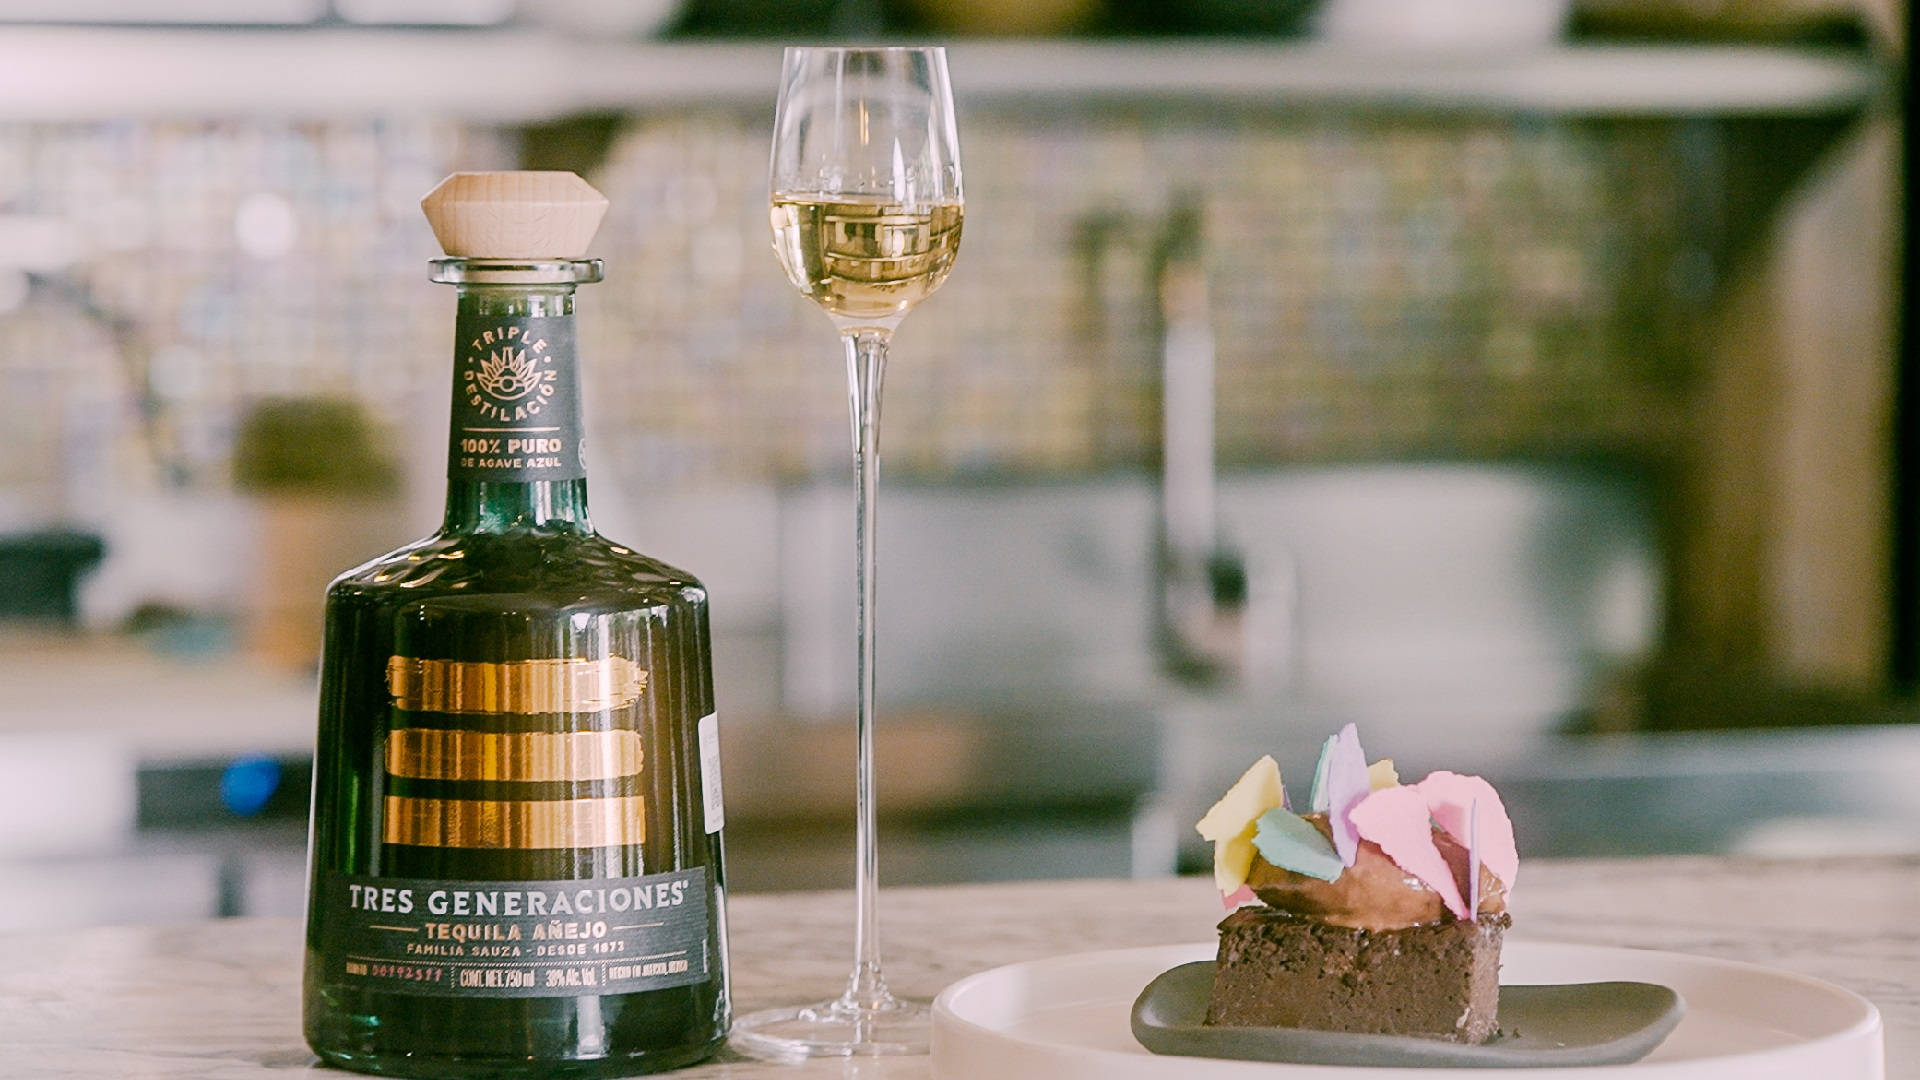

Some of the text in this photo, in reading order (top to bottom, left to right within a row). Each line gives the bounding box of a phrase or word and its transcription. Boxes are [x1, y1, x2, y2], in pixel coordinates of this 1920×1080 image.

[472, 326, 547, 354] TRIPLE
[464, 370, 557, 422] DESTILACIÓN
[460, 438, 562, 454] 100% PURO
[461, 457, 562, 468] DE AGAVE AZUL
[349, 884, 414, 914] TRES
[425, 919, 608, 943] TEQUILA AÑEJO
[407, 941, 625, 957] FAMILIA SAUZA DESDE 1873
